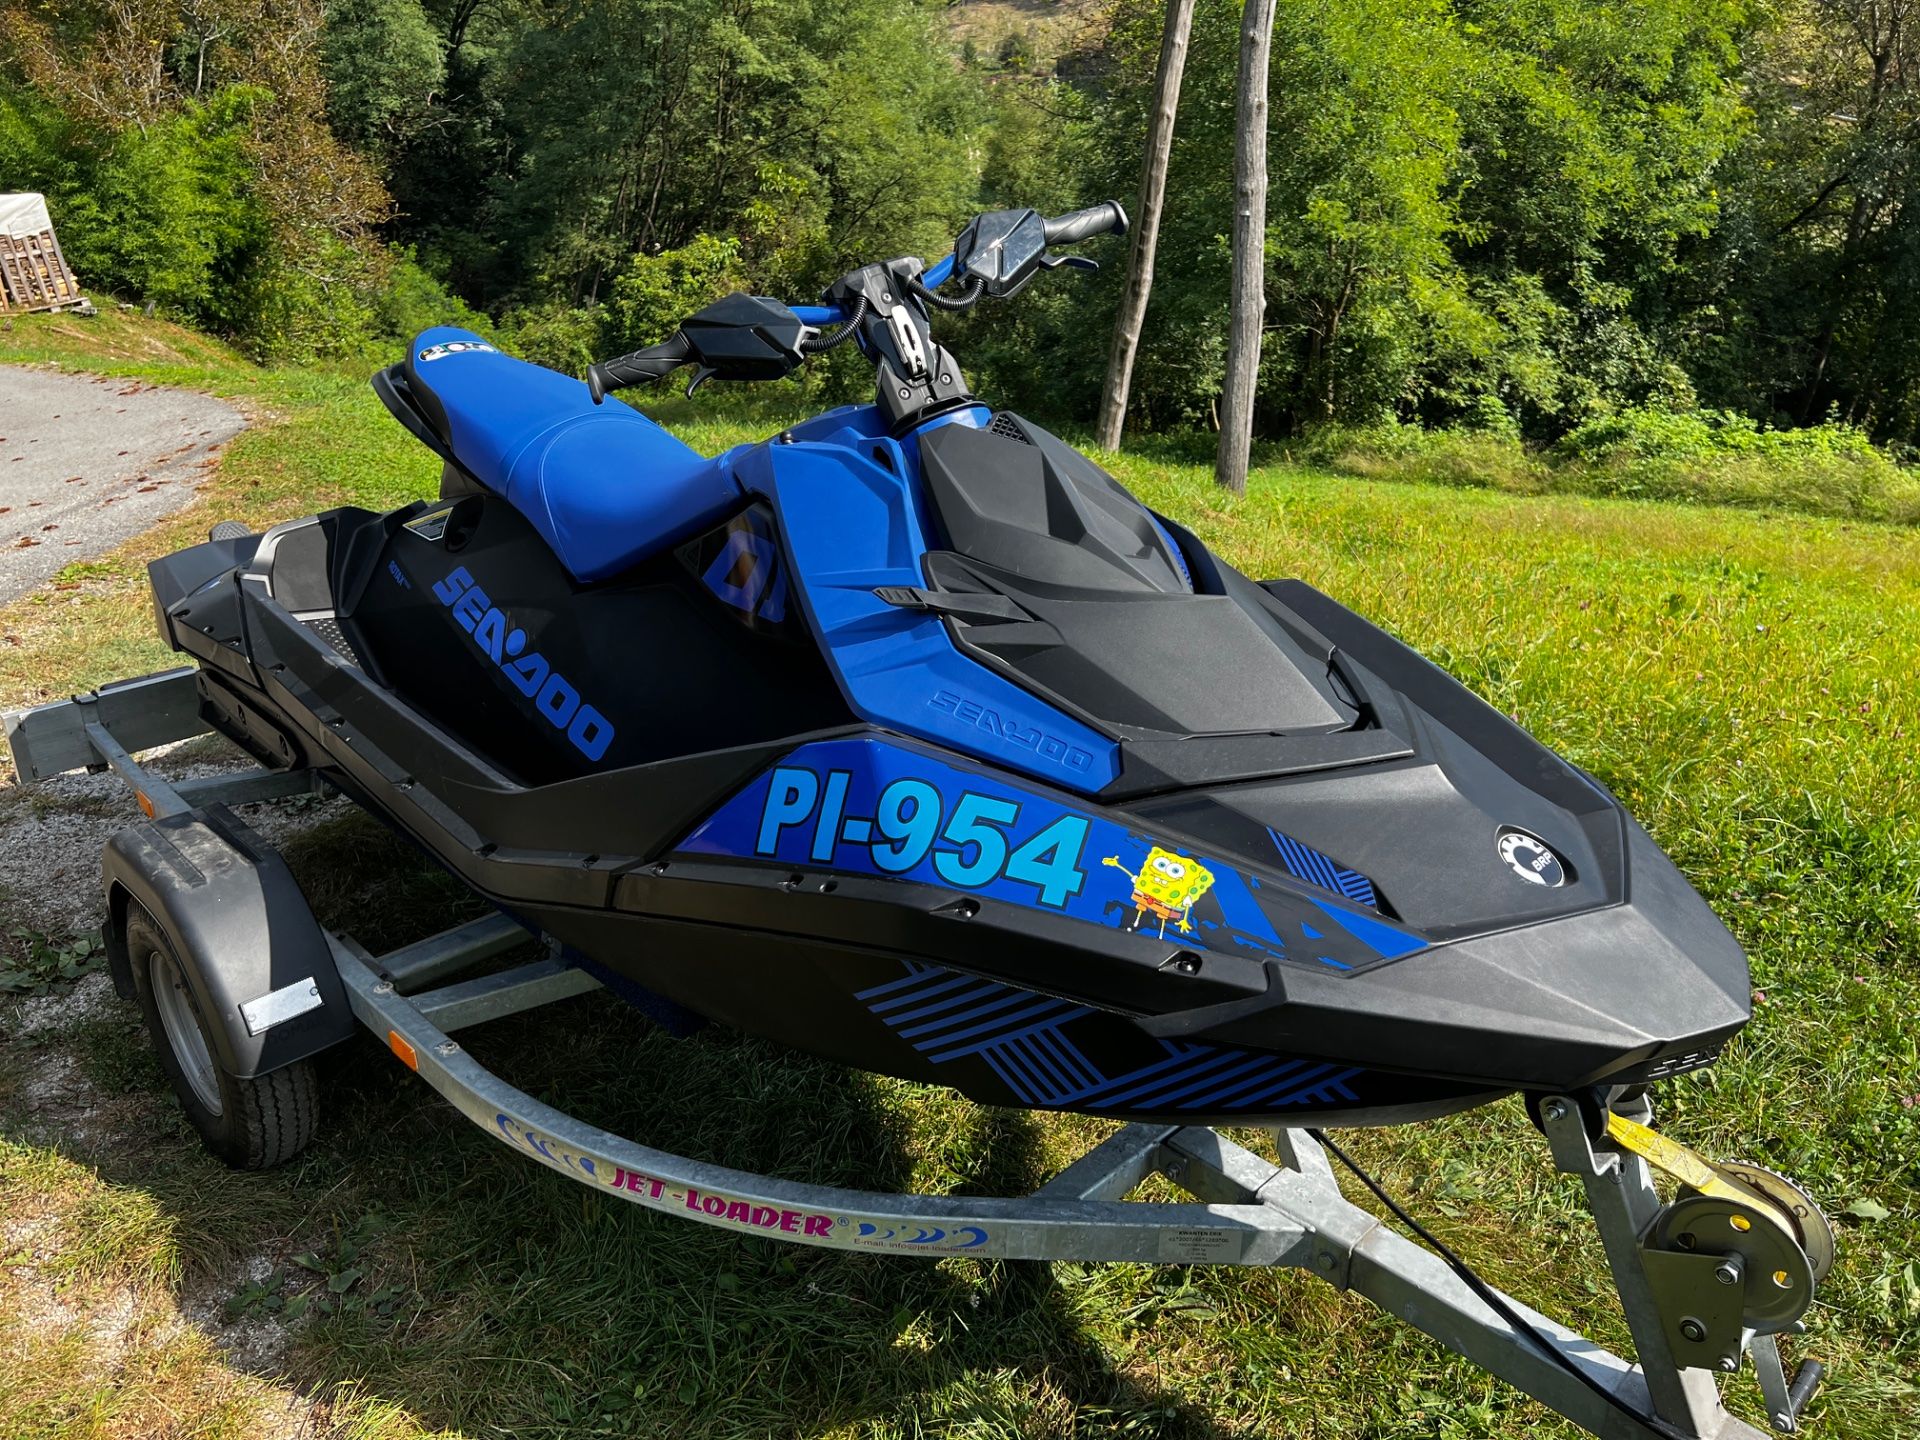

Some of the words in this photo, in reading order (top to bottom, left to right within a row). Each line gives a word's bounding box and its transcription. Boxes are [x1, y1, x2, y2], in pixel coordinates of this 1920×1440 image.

[755, 765, 1092, 909] PI-954
[1531, 851, 1552, 872] BRP
[889, 1243, 987, 1254] info@jet-loader.com
